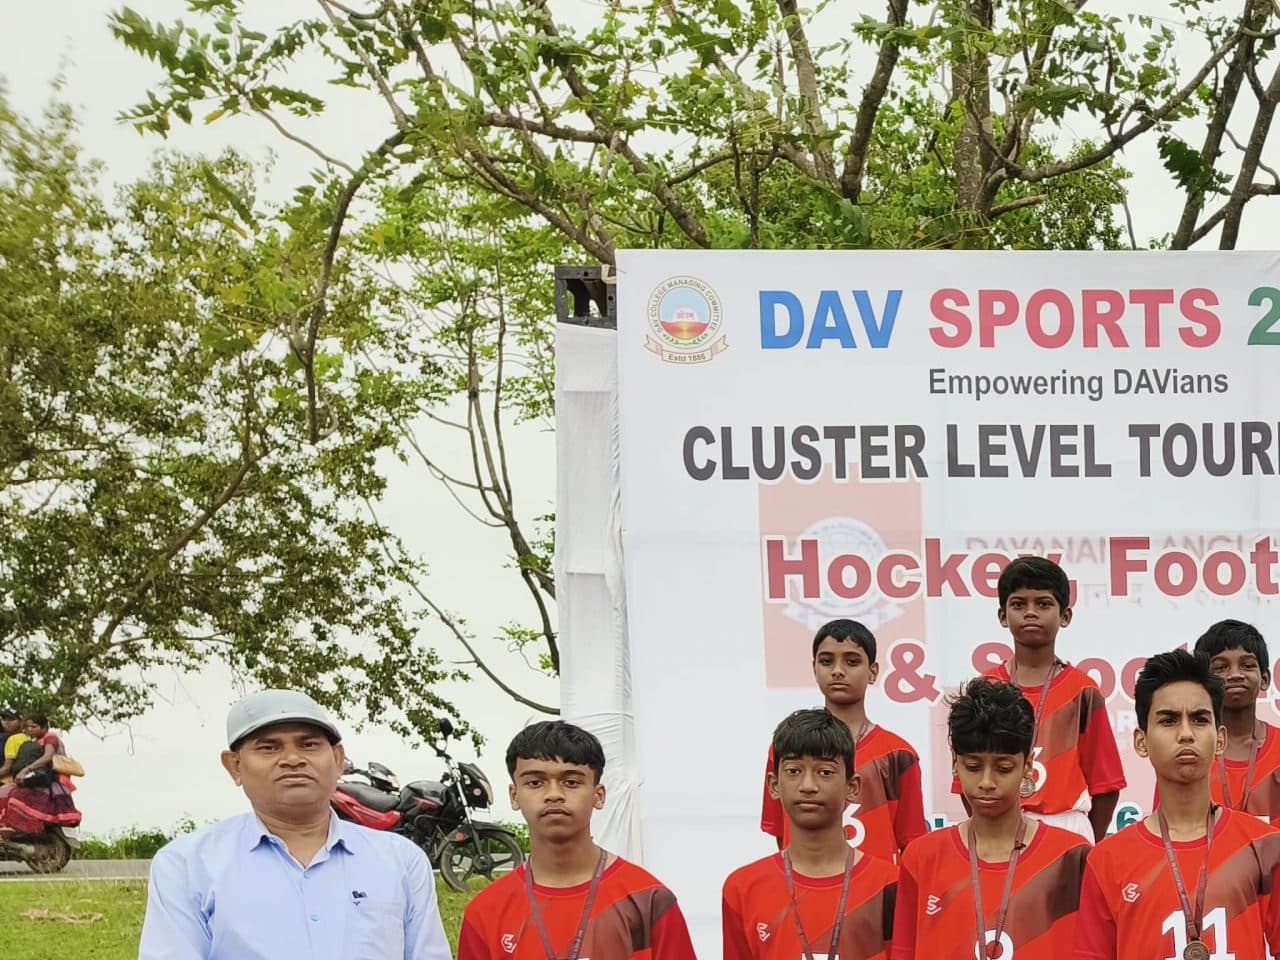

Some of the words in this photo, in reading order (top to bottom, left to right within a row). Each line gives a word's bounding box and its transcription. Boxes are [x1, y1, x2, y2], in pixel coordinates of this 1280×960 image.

[760, 291, 903, 350] DAV
[929, 288, 1221, 349] SPORTS
[929, 368, 1103, 402] Empowering
[1113, 368, 1229, 395] DAVians
[682, 424, 929, 481] CLUSTER
[946, 423, 1112, 478] LEVEL
[767, 537, 1077, 608] Hocke,
[884, 642, 940, 703] &
